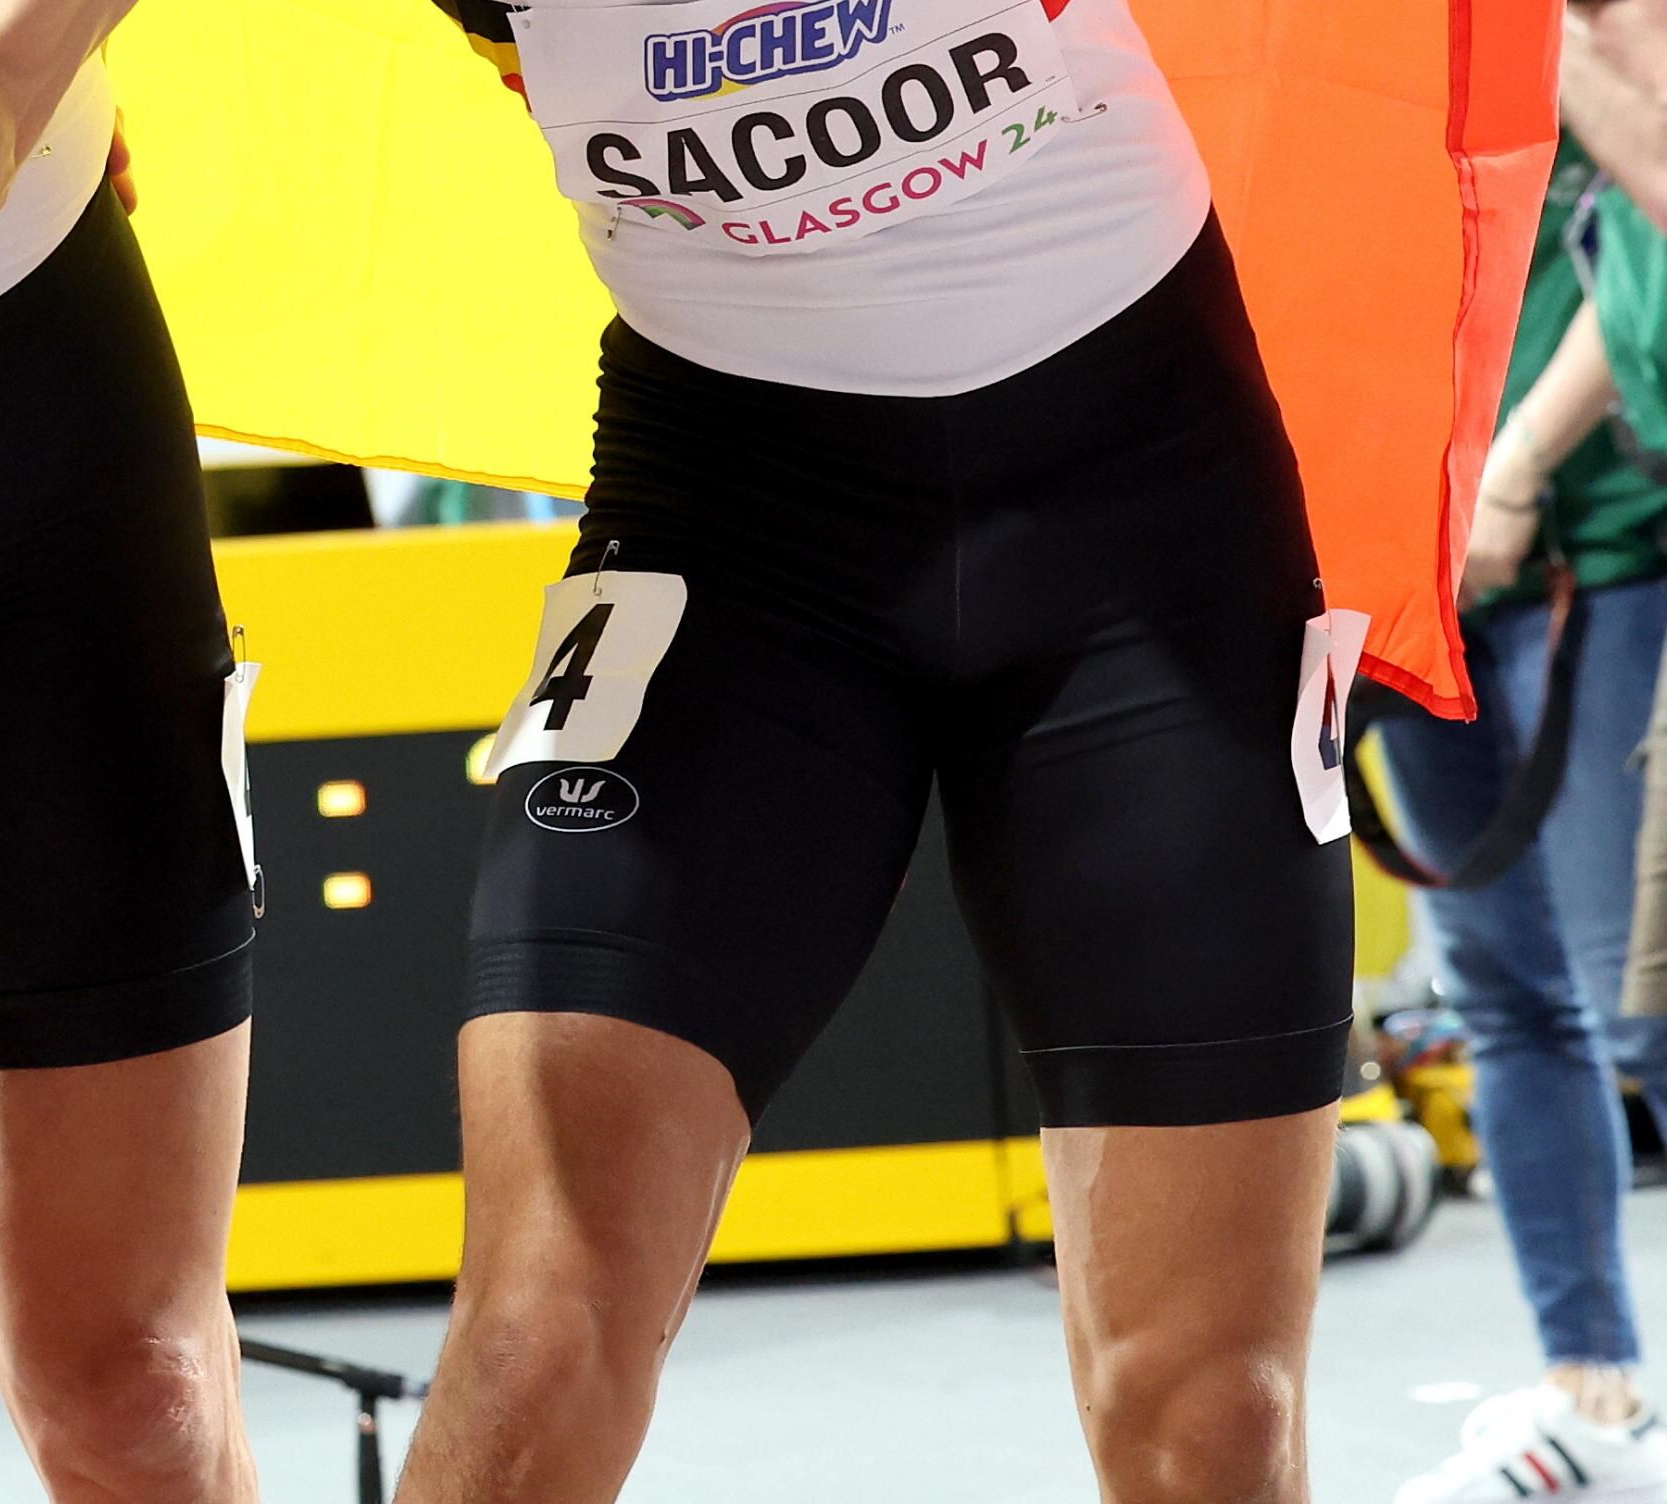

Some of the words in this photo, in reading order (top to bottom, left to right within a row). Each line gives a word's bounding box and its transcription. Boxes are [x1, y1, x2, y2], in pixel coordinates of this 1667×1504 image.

[586, 31, 1032, 204] SACOOR
[722, 139, 990, 244] GLASGOW
[1001, 105, 1059, 155] 24
[529, 602, 615, 732] 4
[535, 803, 616, 821] vermarc
